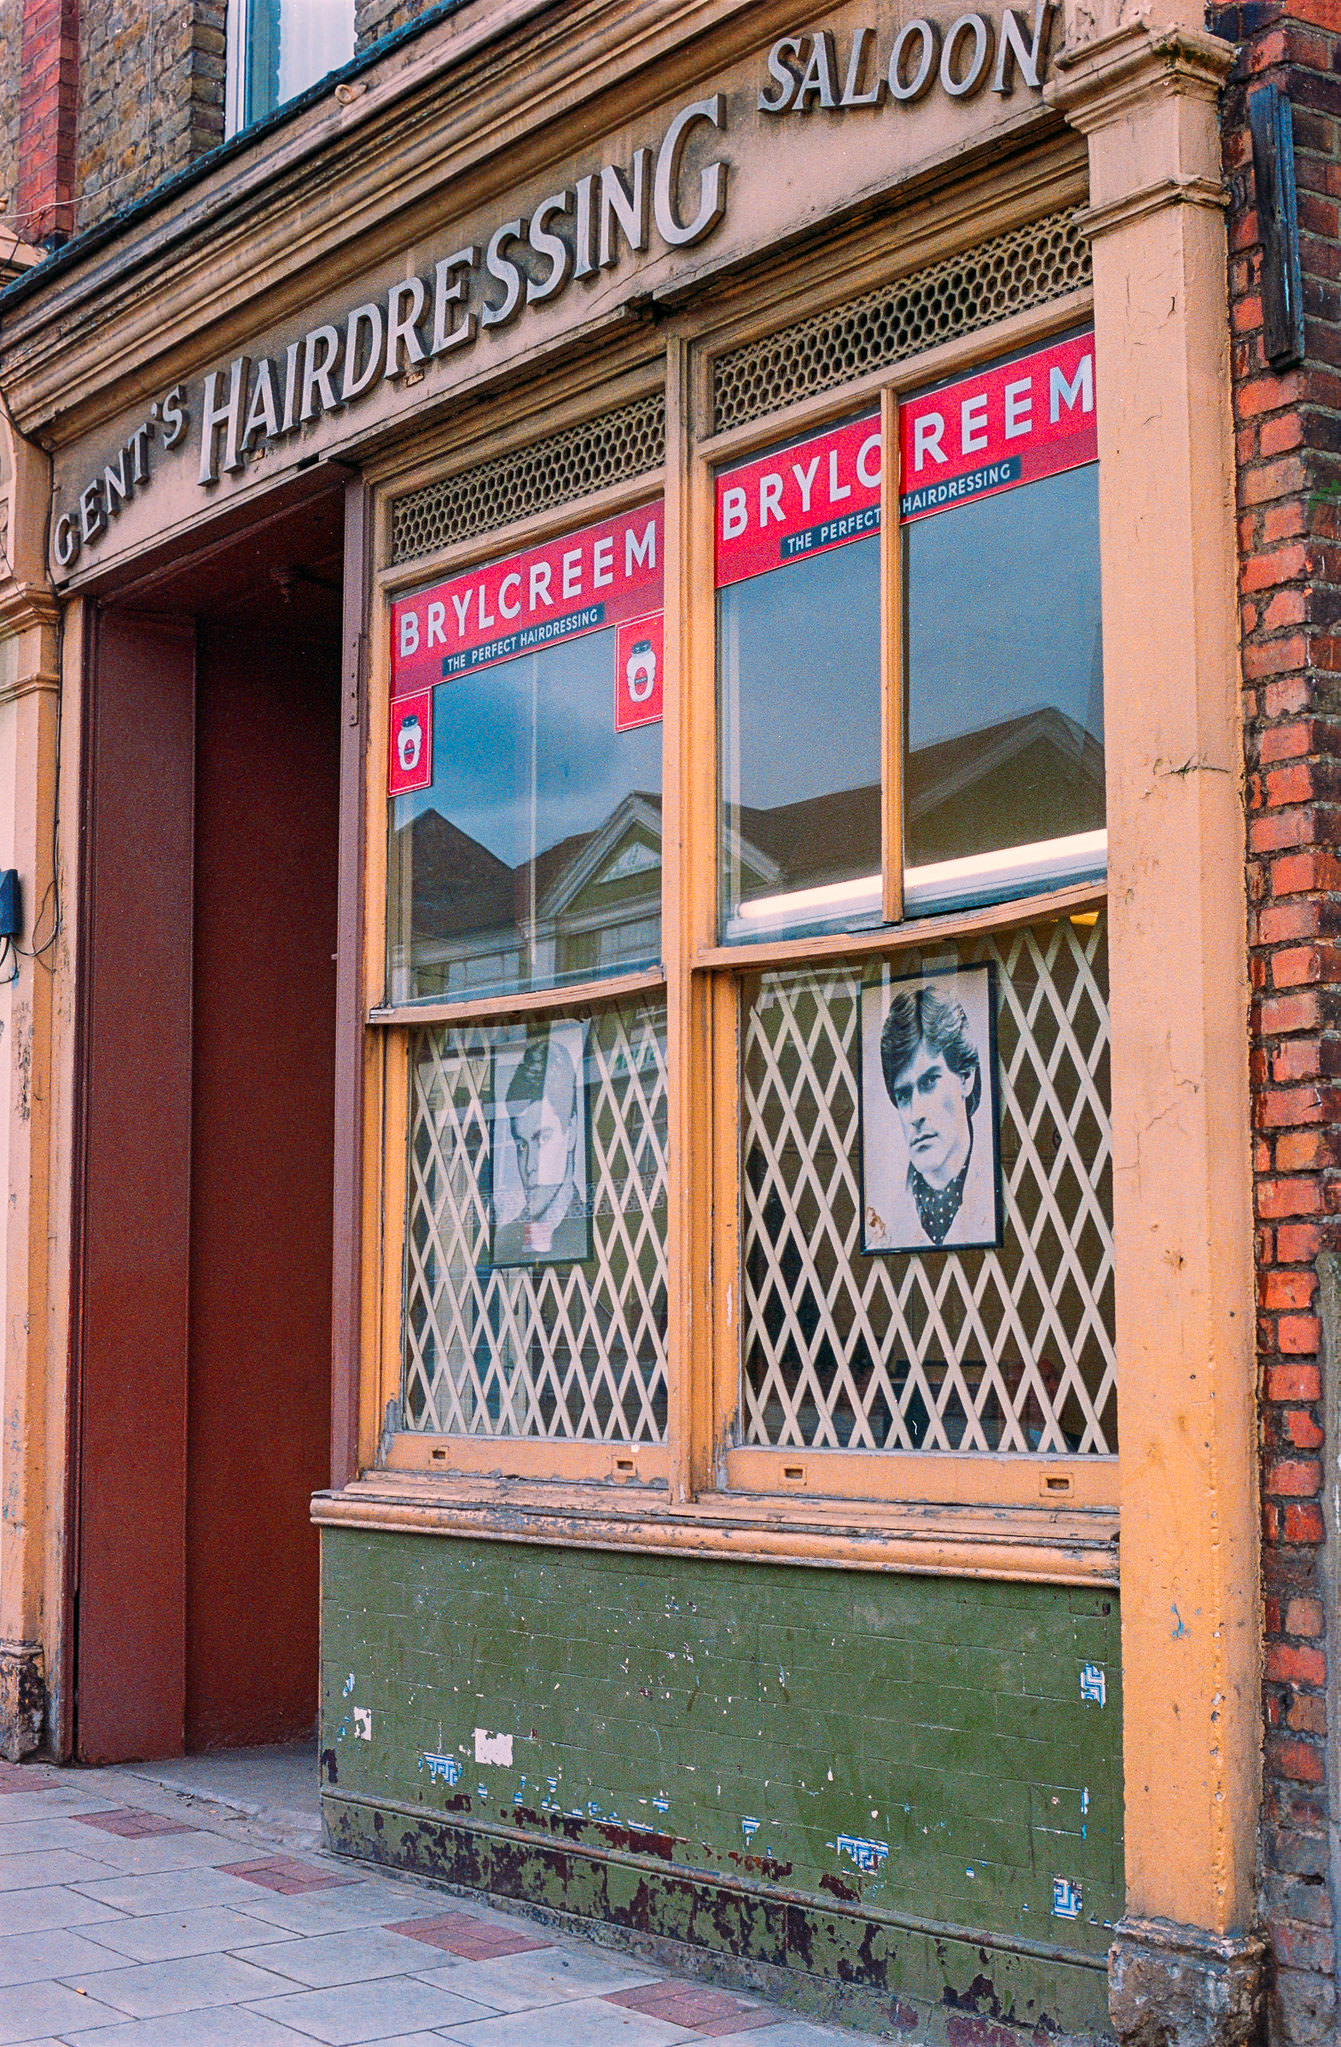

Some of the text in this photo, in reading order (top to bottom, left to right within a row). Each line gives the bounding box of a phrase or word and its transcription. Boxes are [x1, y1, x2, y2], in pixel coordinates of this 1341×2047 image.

[54, 0, 1050, 566] GENT'S HAIRDRESSING SALOON
[786, 464, 1011, 554] THE PERFECT HAIRDRESSING
[400, 520, 656, 658] BRYLCREEM
[447, 608, 598, 672] THE PERFECT HAIRDRESSING
